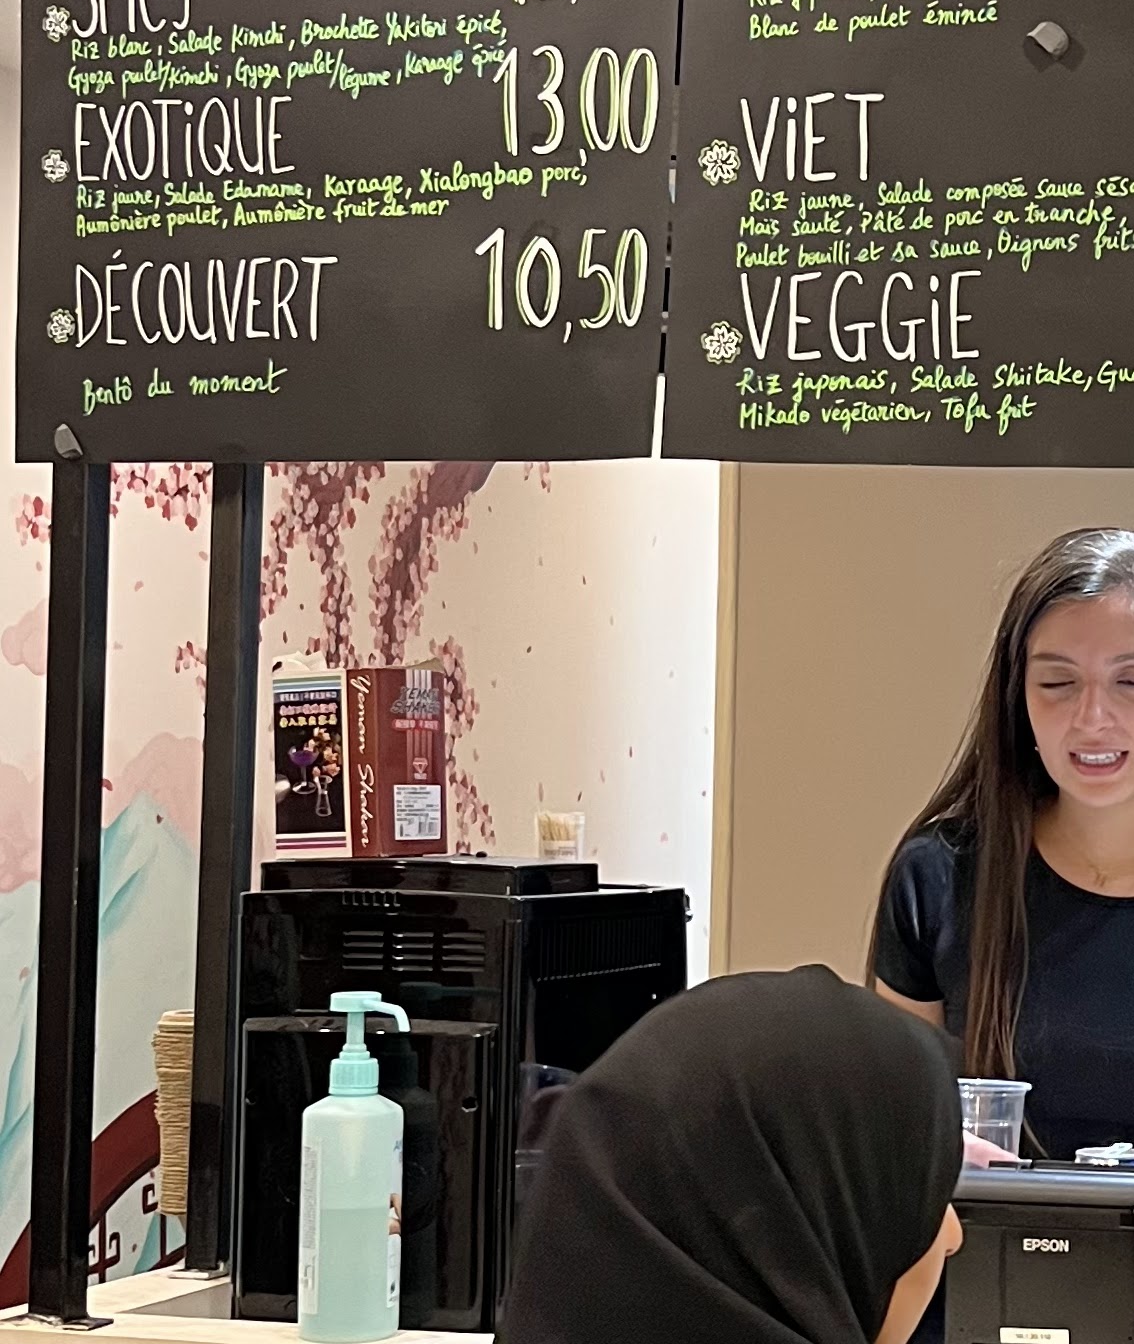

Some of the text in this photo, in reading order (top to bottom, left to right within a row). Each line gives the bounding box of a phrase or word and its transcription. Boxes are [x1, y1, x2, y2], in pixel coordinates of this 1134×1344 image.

[72, 38, 99, 61] Riz
[168, 30, 222, 55] Salade
[301, 15, 379, 44] Brochette
[749, 0, 999, 41] Blanc de poulet émincé
[493, 45, 660, 167] 13,00
[77, 187, 105, 208] Riz
[113, 186, 160, 210] jaune,
[165, 182, 215, 207] Salade
[324, 172, 412, 201] Karaage,
[749, 189, 789, 212] Riz
[800, 192, 864, 216] jaune,
[877, 181, 933, 208] Salade
[946, 176, 1028, 203] composée
[77, 197, 448, 237] Aumônière poulet, Aumônière fruit mer
[792, 212, 853, 238] sauté,
[910, 208, 935, 230] de
[944, 207, 986, 236] porc
[995, 211, 1018, 225] en
[1024, 202, 1127, 228] tranche,
[736, 243, 789, 269] Poulet
[797, 238, 851, 266] bouilli
[854, 240, 879, 262] et
[997, 229, 1080, 271] Oignons
[75, 250, 337, 348] DÉCOUVERT
[476, 227, 649, 343] 10,50
[83, 360, 287, 415] Bentô du moment
[738, 368, 783, 395] Riz
[792, 367, 896, 402] japonais,
[910, 362, 978, 392] Salade
[993, 360, 1094, 392] Shiitake,
[740, 394, 1036, 436] Mikado Tofu frit
[1023, 1238, 1069, 1253] EPSON
